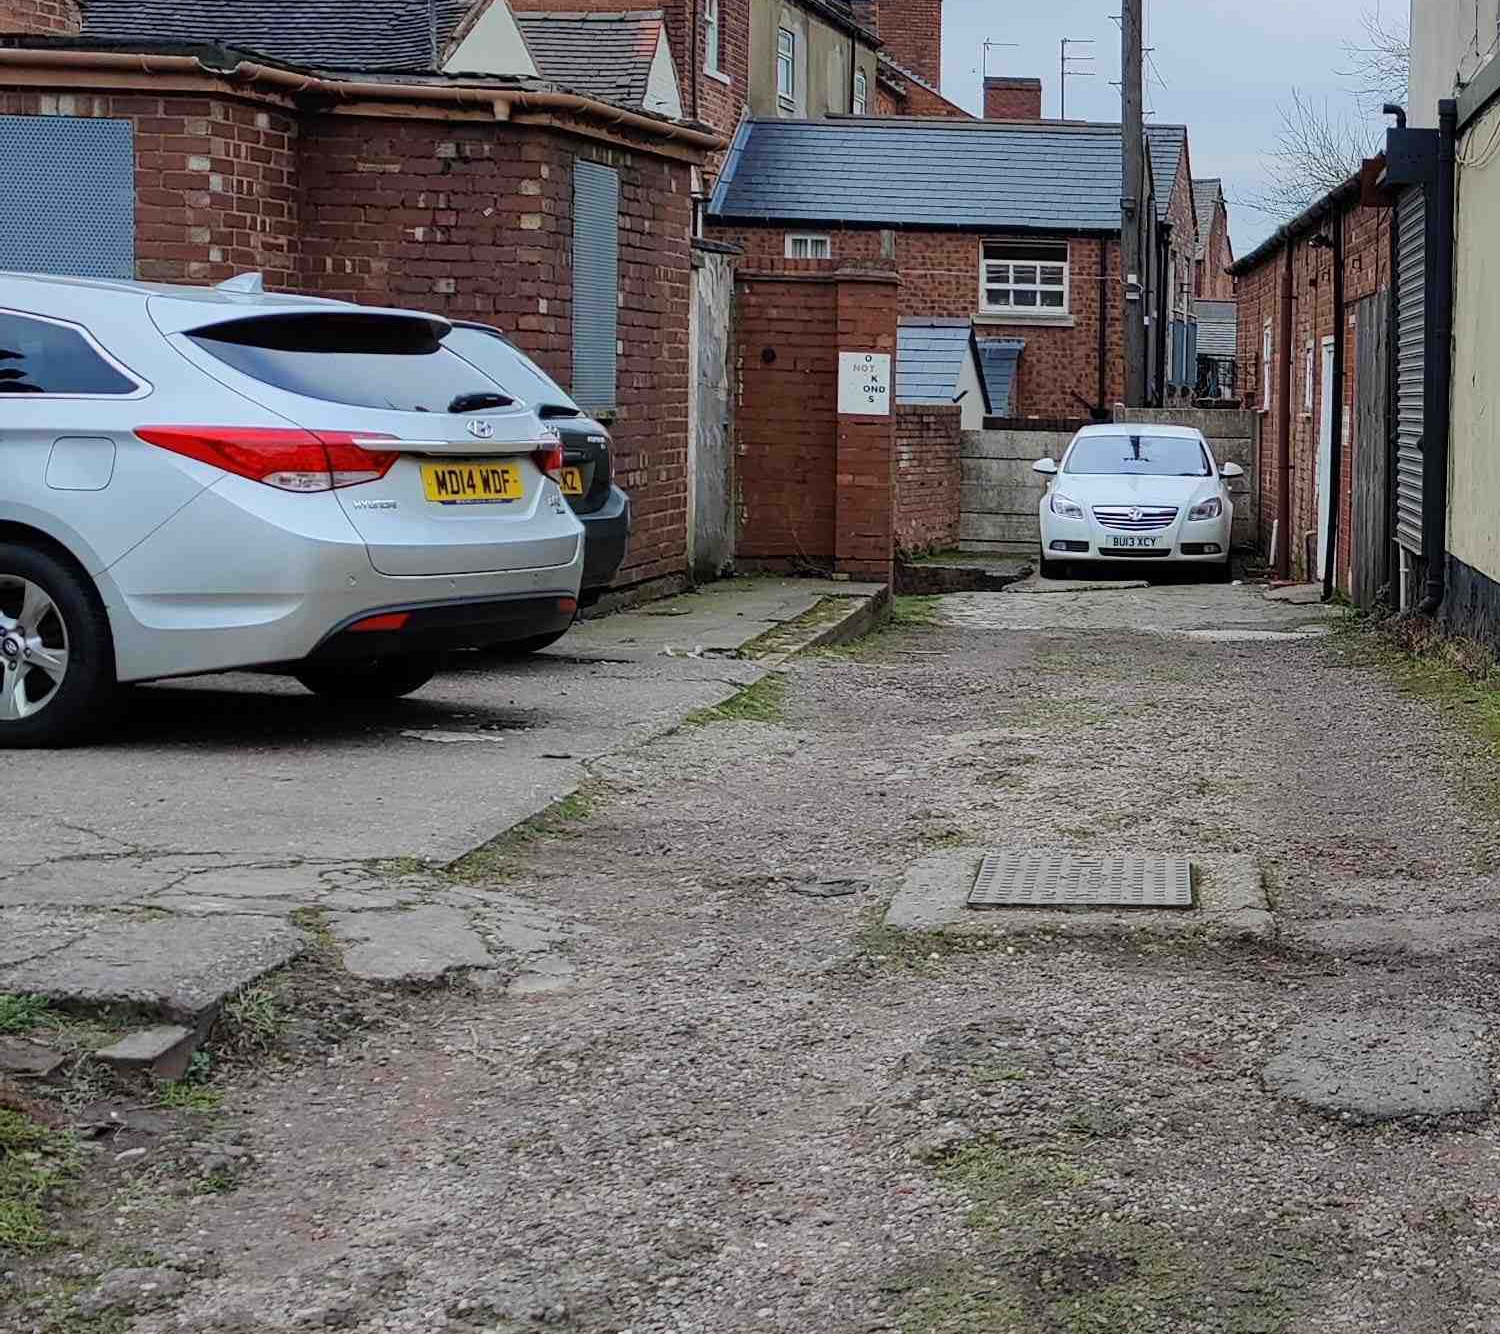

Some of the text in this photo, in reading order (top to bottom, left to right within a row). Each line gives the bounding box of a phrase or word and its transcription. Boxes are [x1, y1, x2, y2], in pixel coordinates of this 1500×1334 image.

[433, 468, 510, 496] MD14 WDF
[1113, 537, 1157, 547] BU13 XCY
